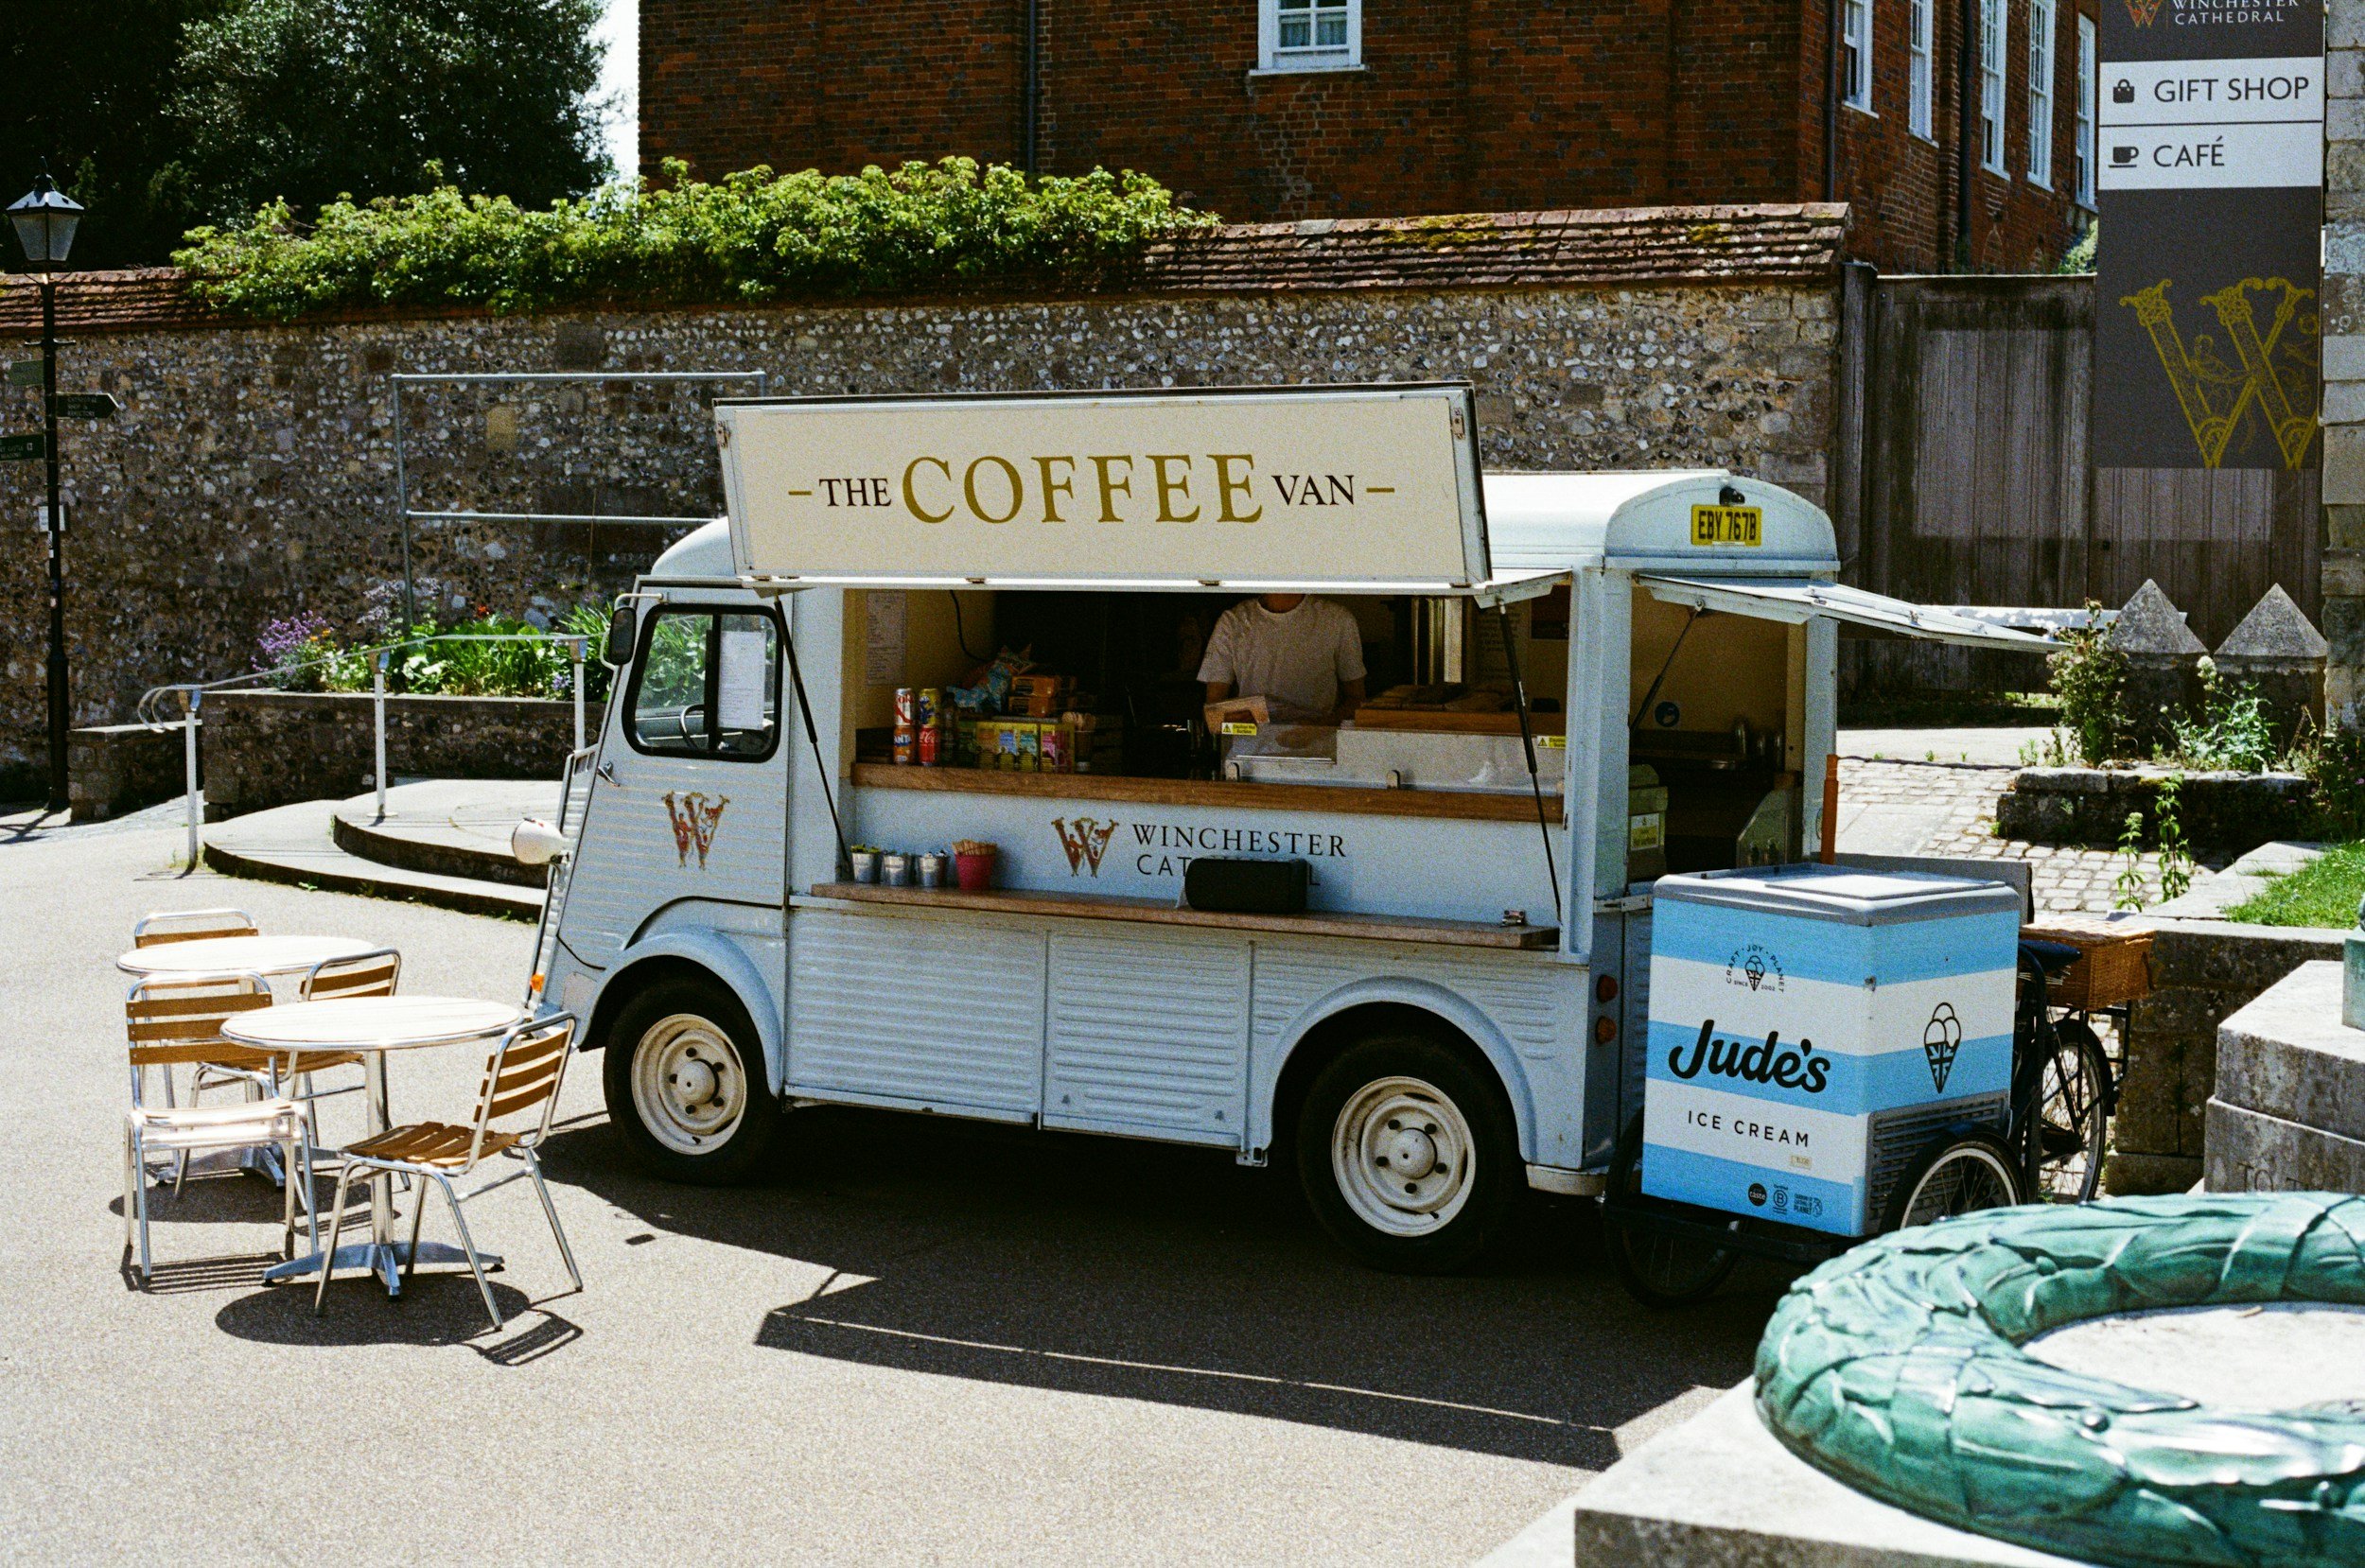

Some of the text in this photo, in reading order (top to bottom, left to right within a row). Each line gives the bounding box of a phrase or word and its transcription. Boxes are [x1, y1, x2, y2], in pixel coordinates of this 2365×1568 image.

[2173, 0, 2299, 10] WINCHESTER
[2175, 10, 2285, 26] CATHEDRAL
[2154, 77, 2309, 102] GIFT SHOP
[2153, 135, 2225, 167] CAFÉ
[818, 453, 1356, 524] THE COFFEE VAN
[1698, 510, 1723, 540] EBY
[1131, 823, 1346, 858] WINCHESTER
[1726, 950, 1740, 984] CRAFT
[1770, 954, 1785, 993] PLANET
[1668, 1019, 1831, 1094] Jude's
[1688, 1110, 1810, 1147] ICE CREAM
[1749, 1191, 1766, 1201] taste
